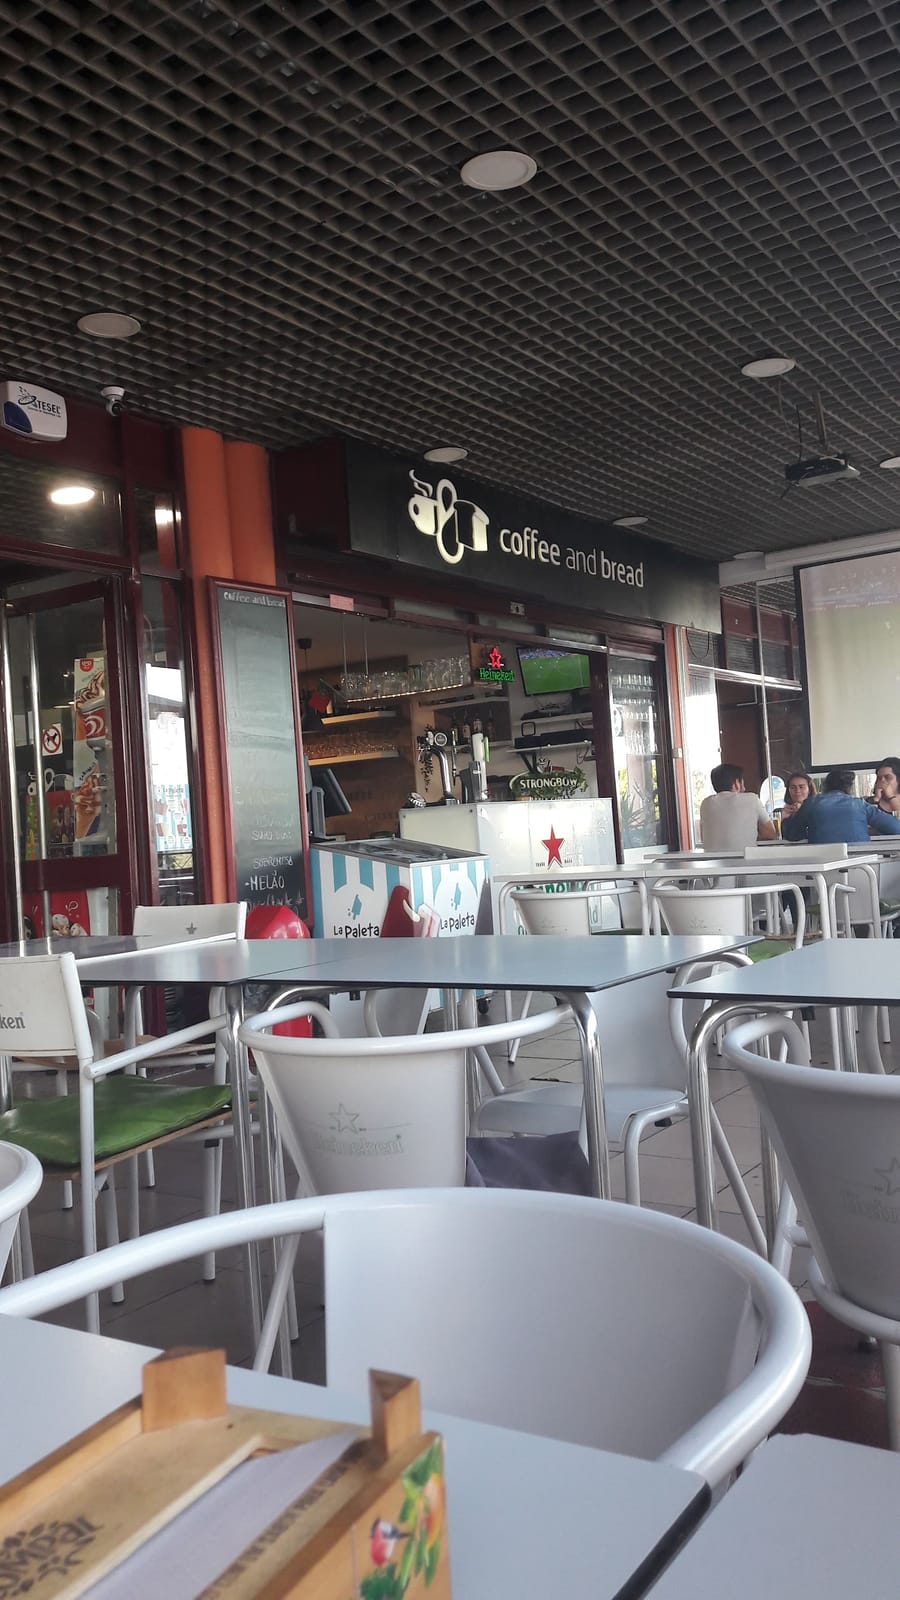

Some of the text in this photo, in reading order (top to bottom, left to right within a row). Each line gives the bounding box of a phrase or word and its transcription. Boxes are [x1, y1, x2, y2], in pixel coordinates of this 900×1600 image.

[499, 527, 645, 588] coffee and bread
[479, 667, 515, 682] Heineken
[519, 776, 578, 789] STRONGBOW
[333, 922, 380, 938] La Paleta
[440, 912, 475, 932] La Paleta
